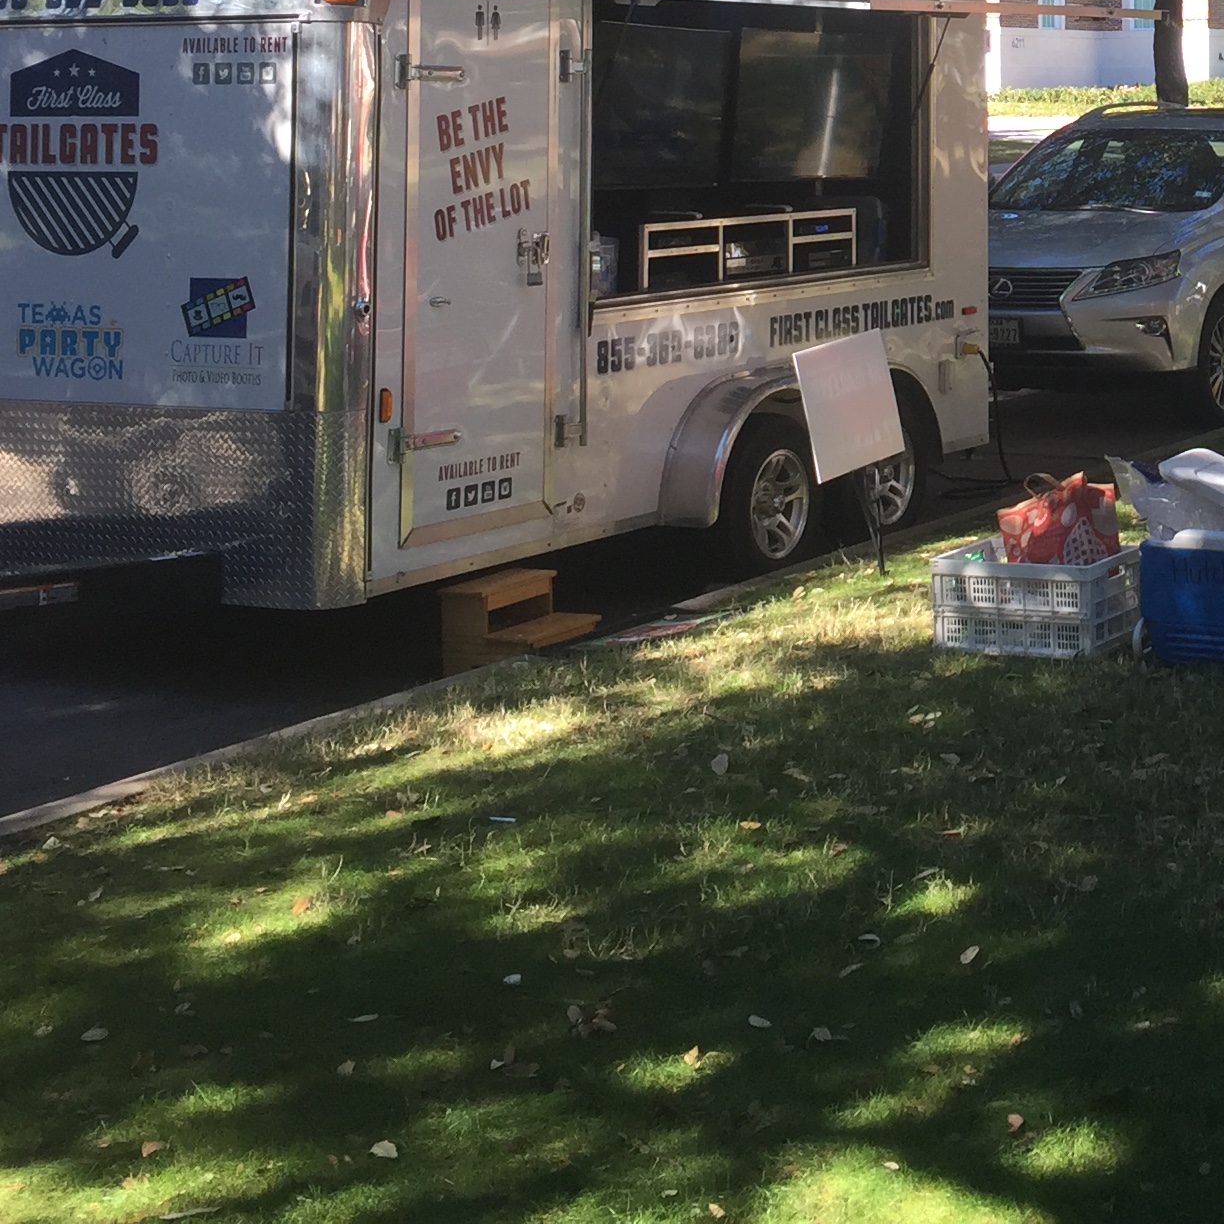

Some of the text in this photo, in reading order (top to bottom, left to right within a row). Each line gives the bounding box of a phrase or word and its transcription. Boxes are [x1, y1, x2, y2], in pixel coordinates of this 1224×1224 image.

[182, 36, 288, 54] AVAILABLE TO RENT
[26, 84, 122, 110] First Class
[436, 96, 509, 152] BE THE
[449, 142, 505, 195] ENVY
[434, 179, 531, 242] OF THE LOT
[18, 328, 122, 358] PARTY
[769, 294, 955, 348] FIRST CLASS TAILGATES.com
[596, 321, 740, 375] 855-362-6386
[438, 451, 521, 482] AVAILABLE TO RENT
